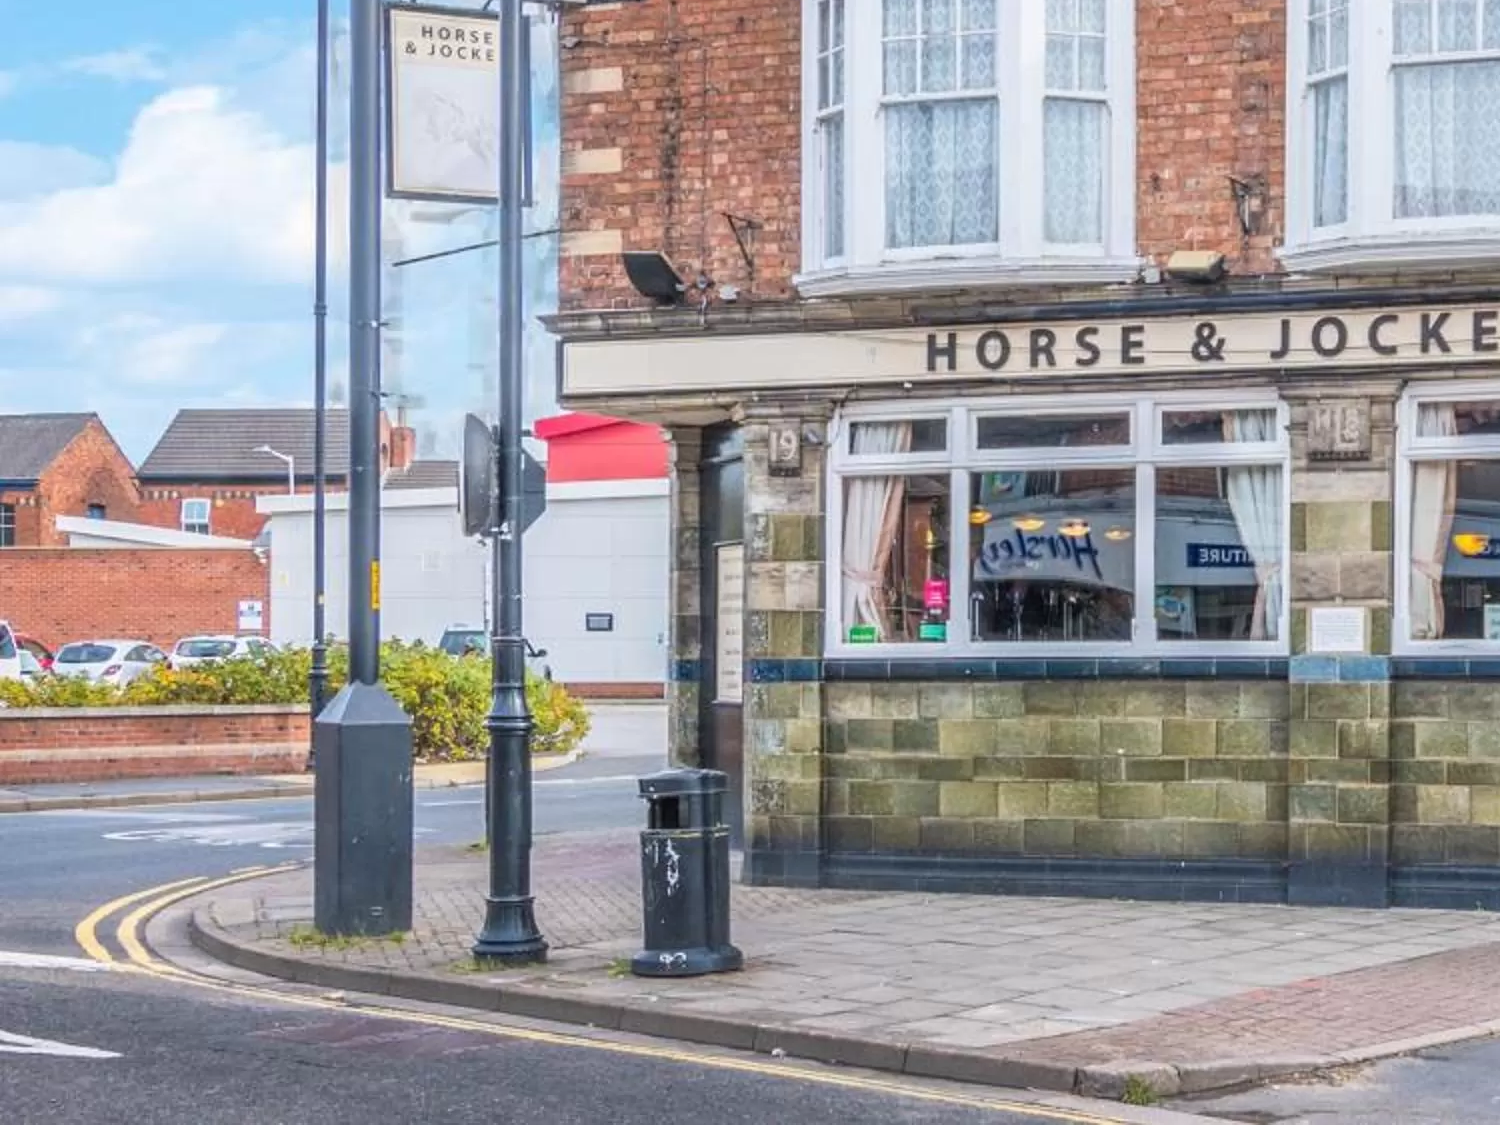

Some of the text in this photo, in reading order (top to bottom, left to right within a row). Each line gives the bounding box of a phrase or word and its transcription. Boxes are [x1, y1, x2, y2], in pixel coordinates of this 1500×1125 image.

[421, 26, 493, 44] HORSE
[405, 41, 495, 62] & JOCKE
[926, 325, 1146, 372] HORSE
[1191, 321, 1226, 362] &
[769, 429, 798, 463] 19
